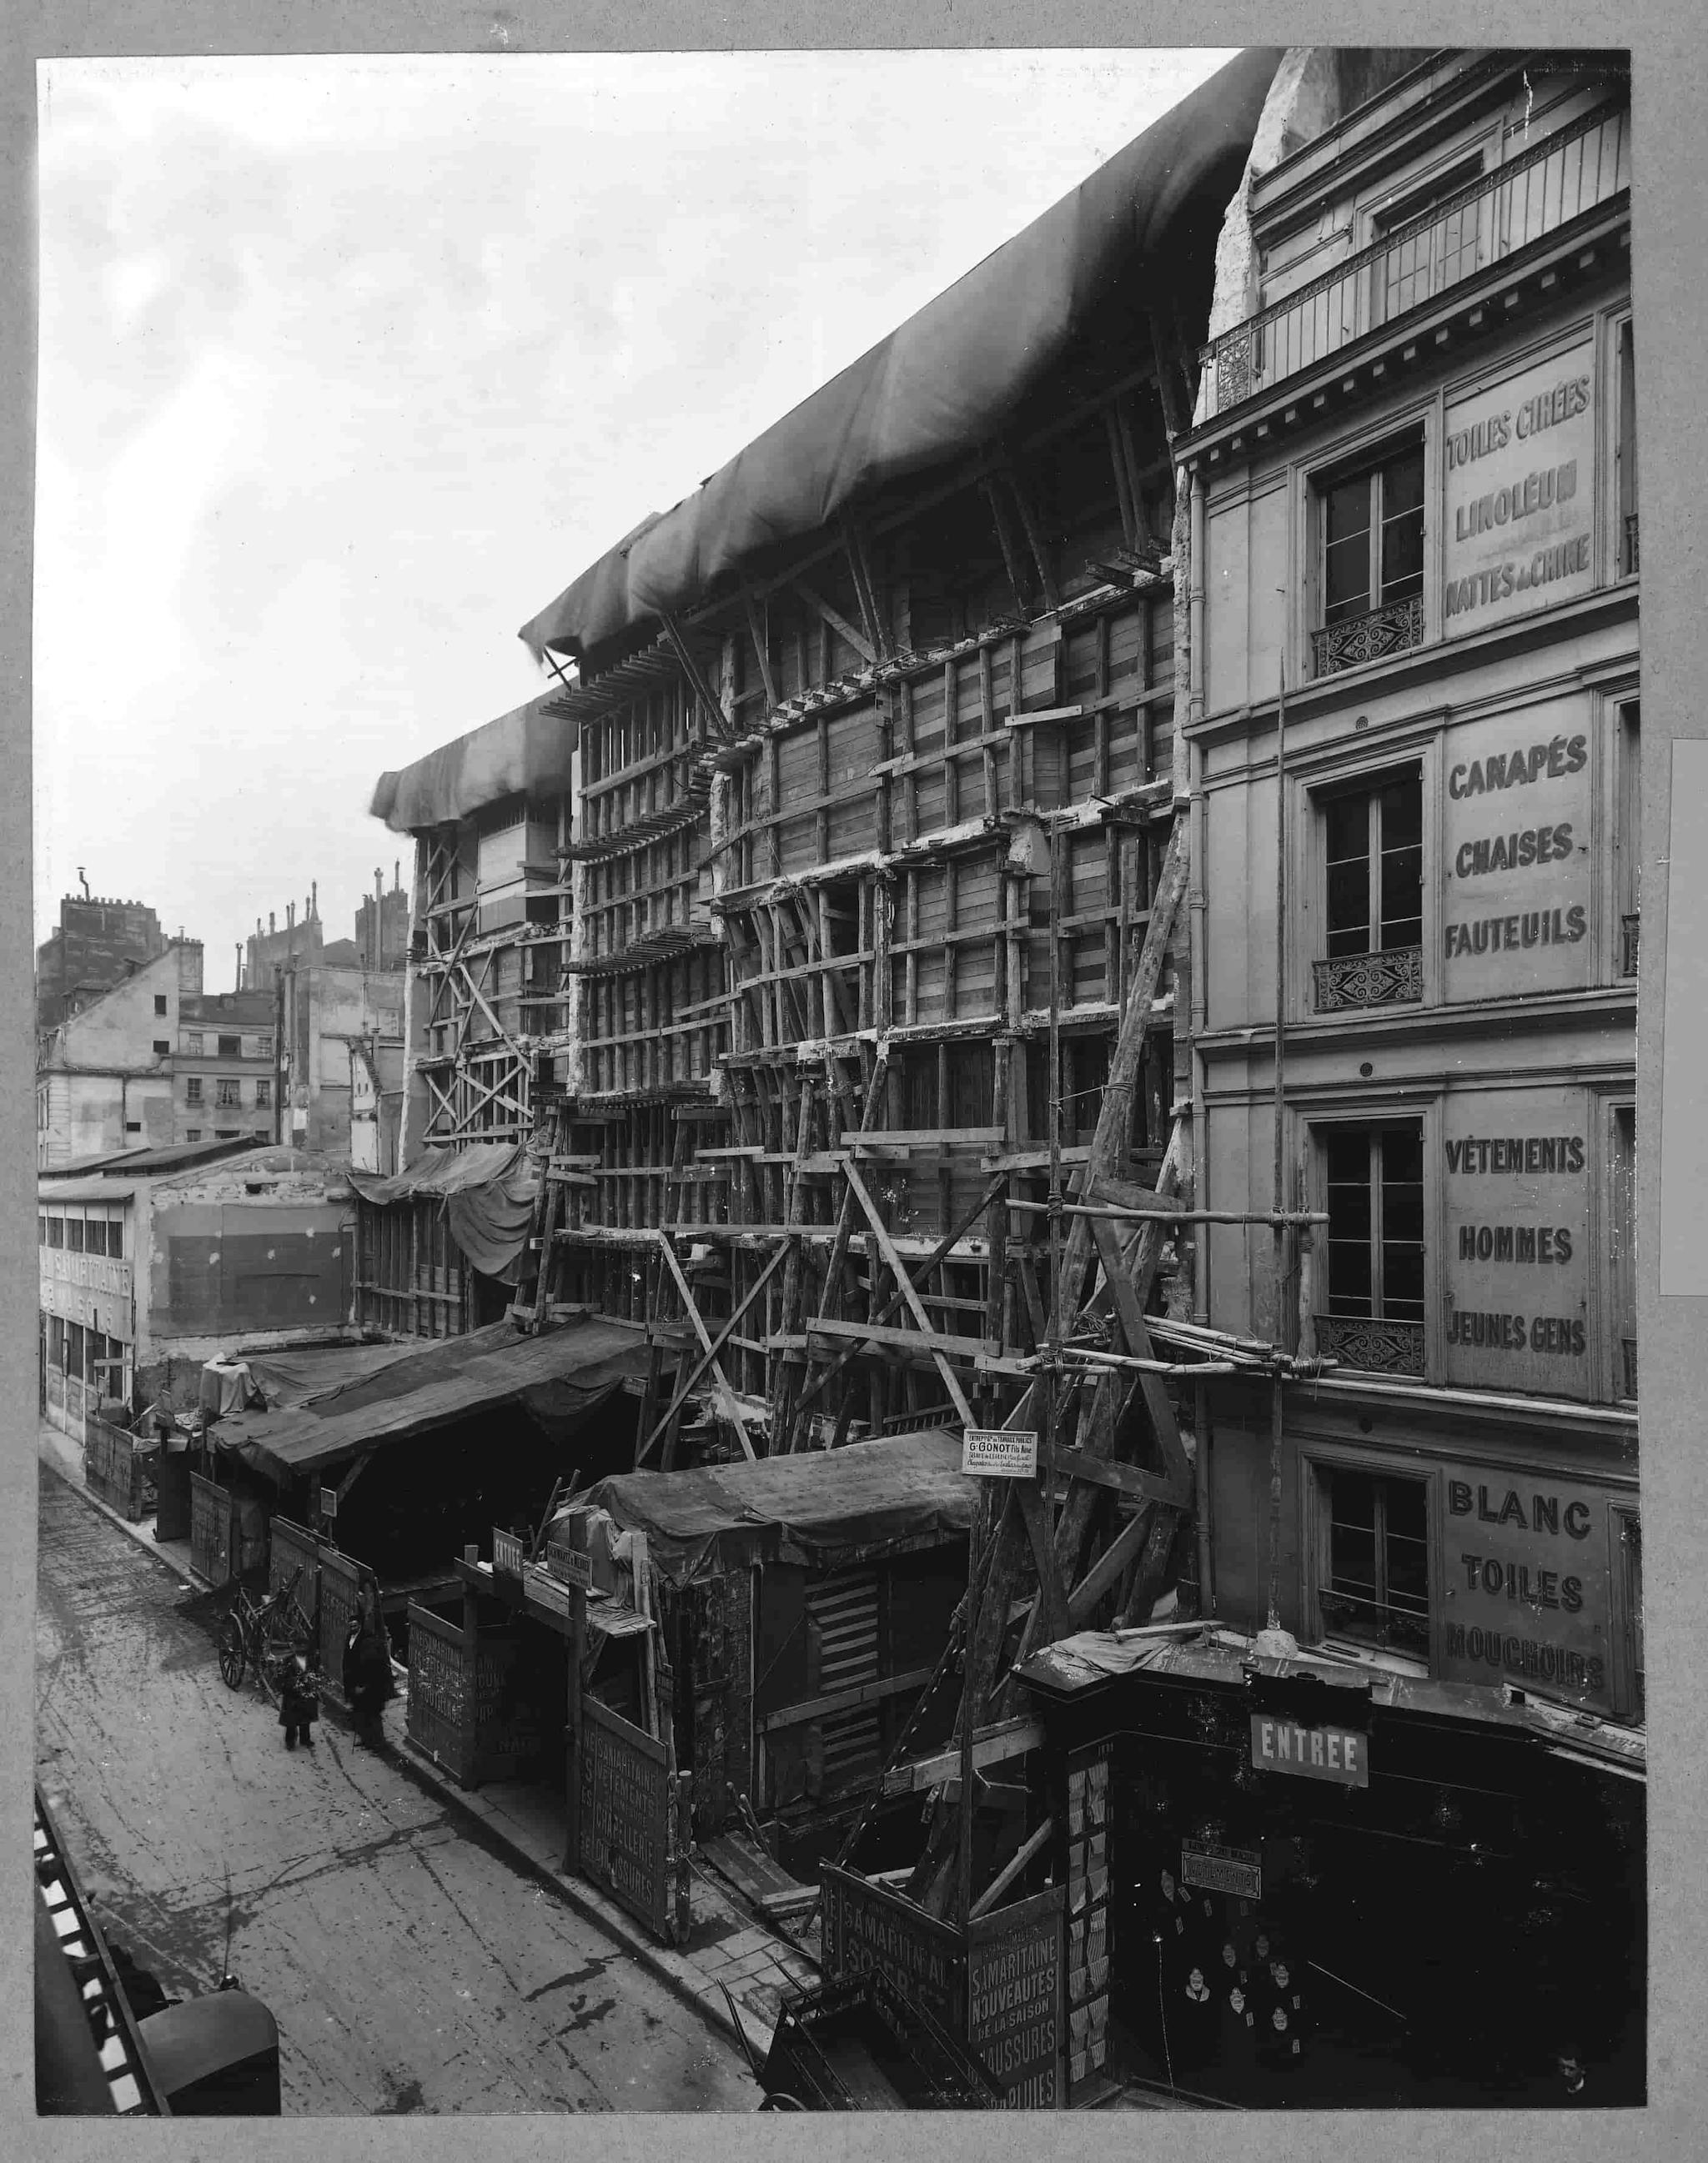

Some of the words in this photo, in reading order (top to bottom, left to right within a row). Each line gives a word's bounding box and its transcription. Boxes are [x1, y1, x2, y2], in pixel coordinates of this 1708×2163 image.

[1447, 410, 1512, 471] TOILES
[1517, 374, 1590, 440] CIRÉES
[1530, 533, 1590, 587] CHINE
[1449, 735, 1587, 800] CANAPÉS
[1456, 822, 1573, 879] CHAISES
[1445, 906, 1587, 960] FAUTEUILS
[1445, 1135, 1585, 1174] VÊTEMENTS
[1459, 1225, 1573, 1265] HOMMES
[1446, 1311, 1528, 1351] JEUNES
[1530, 1317, 1585, 1357] GENS
[1449, 1479, 1591, 1540] BLANC
[1461, 1553, 1584, 1613] TOILES
[972, 1935, 1057, 1997] SAMARITAINE
[994, 2016, 1007, 2035] LA
[1009, 1997, 1050, 2028] SAISON
[982, 2018, 1055, 2077] AUSSURES
